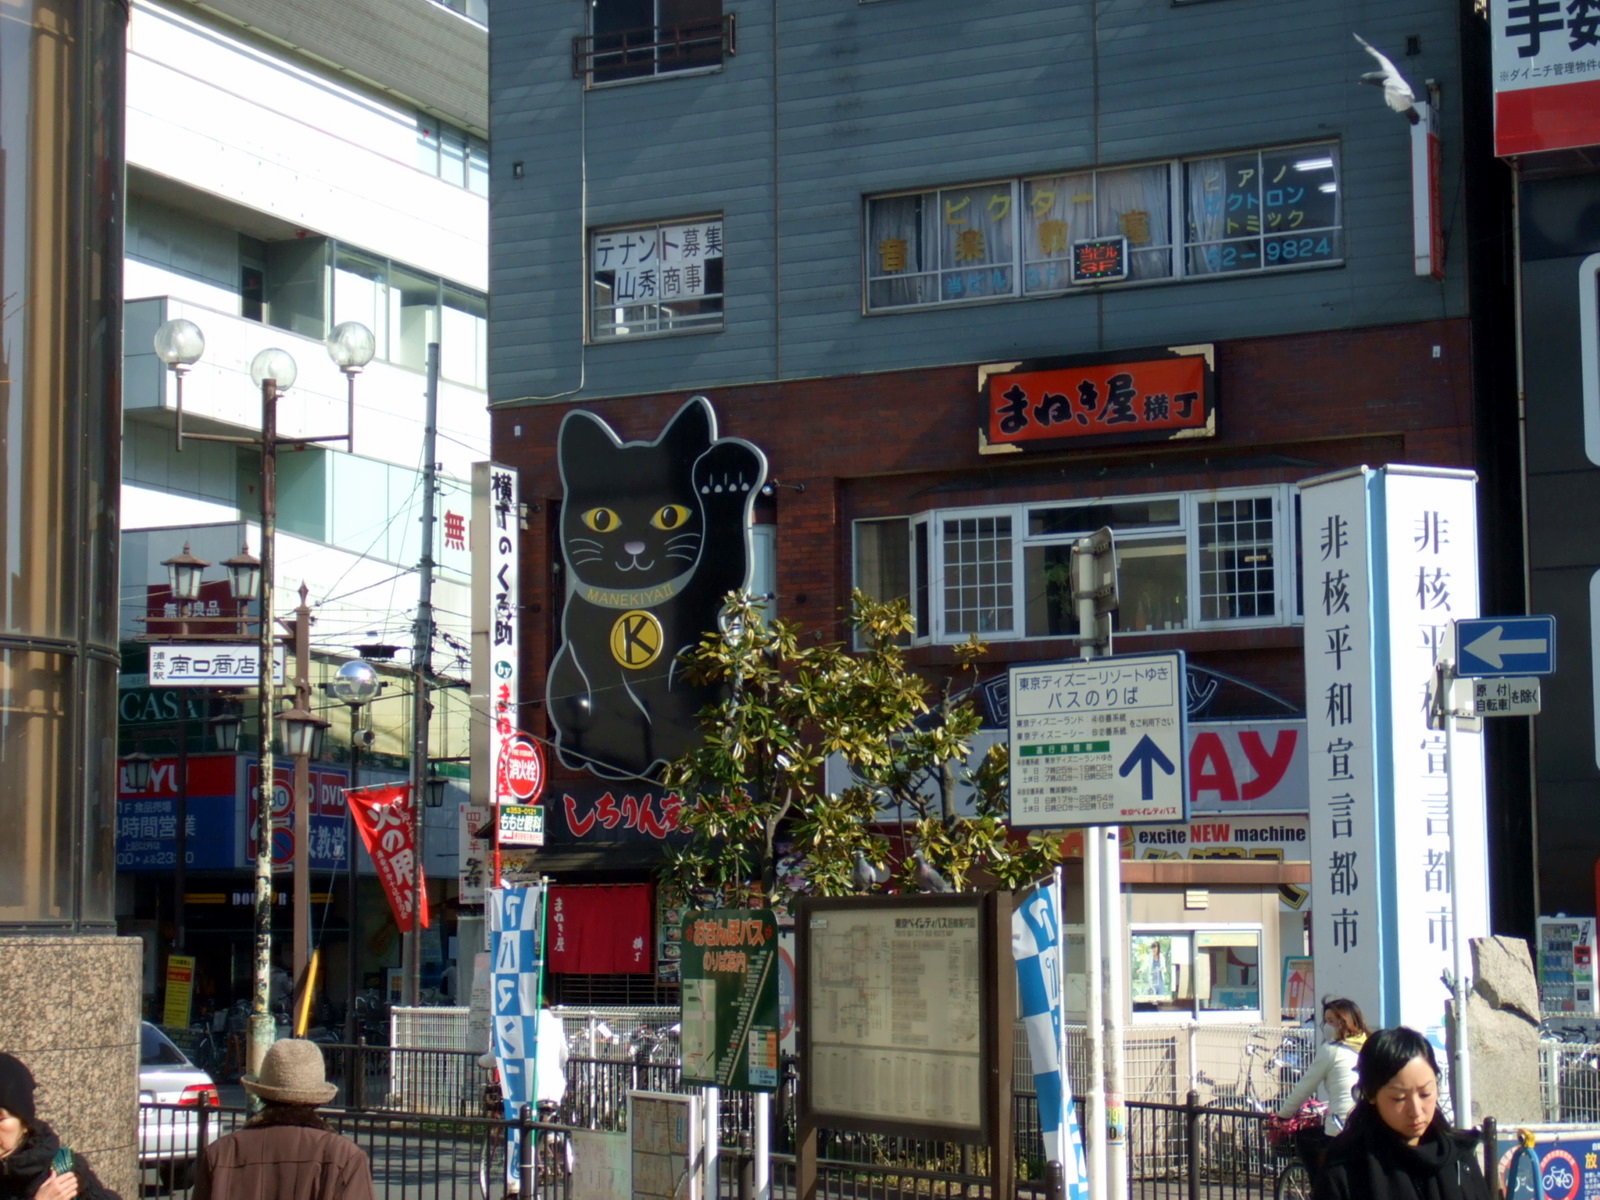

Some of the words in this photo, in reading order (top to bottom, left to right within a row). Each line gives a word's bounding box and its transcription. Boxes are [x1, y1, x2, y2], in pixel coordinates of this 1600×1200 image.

[1500, 58, 1600, 82] ※ダイニチ管理物件
[597, 226, 722, 267] テナント募集
[617, 264, 702, 301] 山秀商事
[164, 600, 220, 618] 無良品
[152, 651, 166, 680] 浦安駅
[1018, 667, 1169, 691] 東京ディズニーリゾートゆき
[1048, 687, 1139, 709] バスのりば
[1476, 699, 1508, 712] 自転車
[1511, 689, 1537, 704] を除く
[1320, 514, 1359, 954] 非核平和宣言都市
[509, 758, 537, 781] 消火栓
[321, 784, 345, 806] DVD
[500, 814, 542, 832] ももせ眼科
[1138, 828, 1186, 844] excite
[1190, 824, 1230, 842] NEW
[1234, 826, 1306, 842] machine
[693, 918, 766, 947] おさんぽバス
